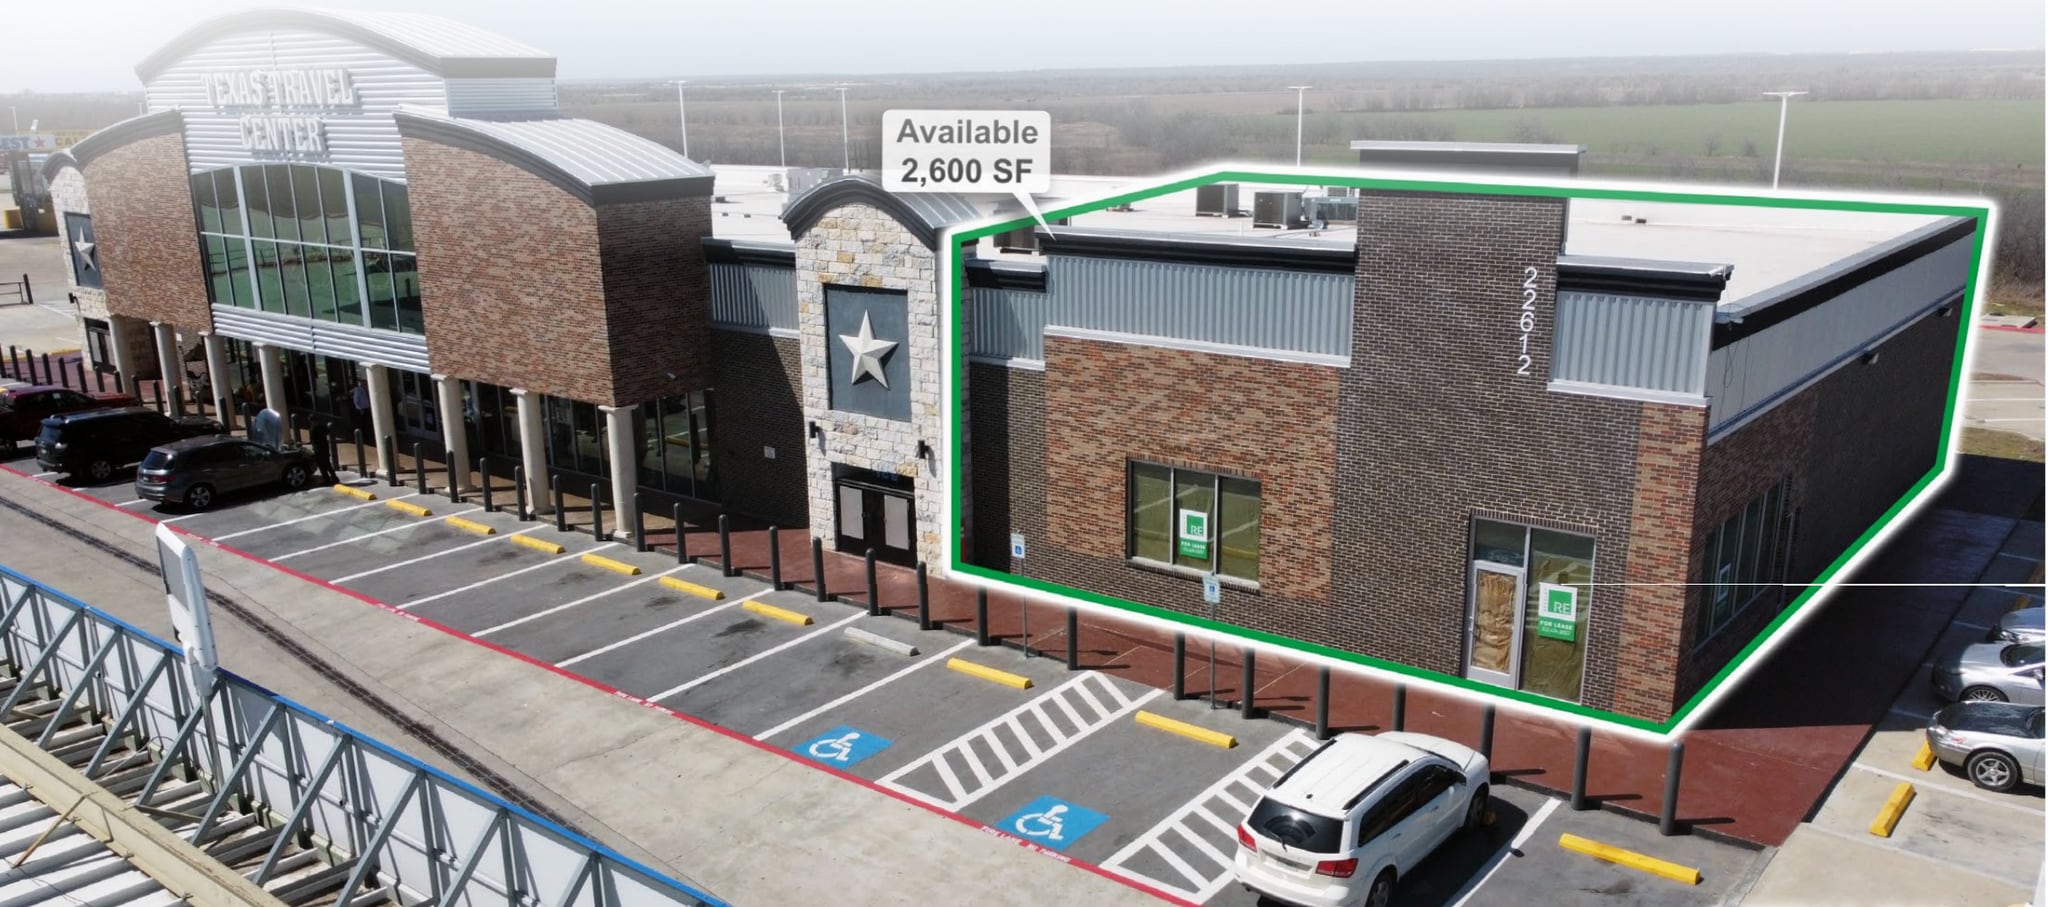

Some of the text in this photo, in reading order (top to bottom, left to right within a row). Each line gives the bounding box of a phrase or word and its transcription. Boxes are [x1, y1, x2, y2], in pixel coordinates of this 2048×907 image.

[200, 68, 356, 105] TEXAS TRAVEL
[240, 114, 324, 152] CENTER
[1517, 266, 1538, 375] 22612
[1554, 602, 1571, 614] RE
[1554, 623, 1573, 631] LEASE
